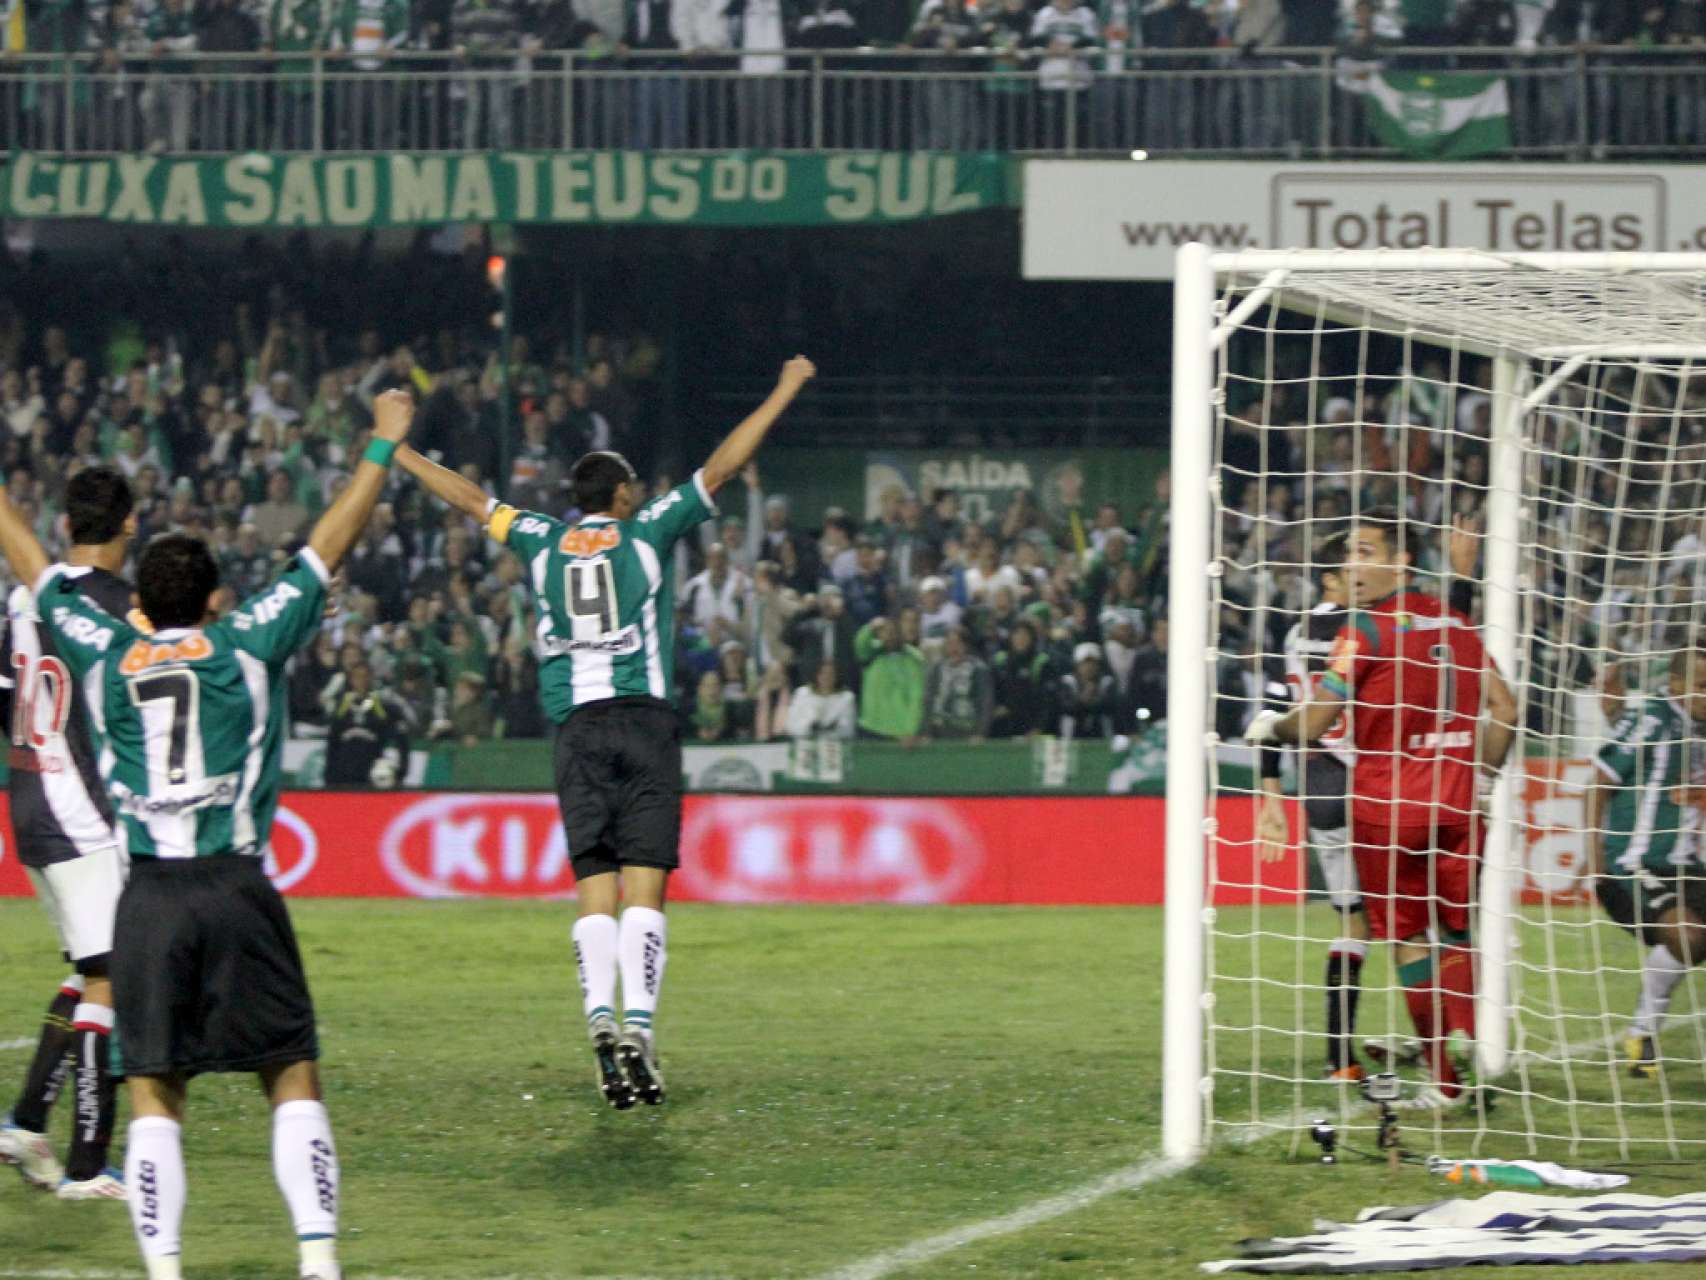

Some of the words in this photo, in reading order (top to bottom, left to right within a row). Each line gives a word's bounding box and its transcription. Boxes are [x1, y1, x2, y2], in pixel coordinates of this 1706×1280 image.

[390, 153, 701, 224] MATEUS
[712, 158, 787, 202] DO
[825, 154, 981, 222] SUL
[1293, 199, 1449, 250] Total
[1474, 199, 1644, 251] Telas
[563, 557, 619, 636] 4
[127, 669, 200, 786] 7
